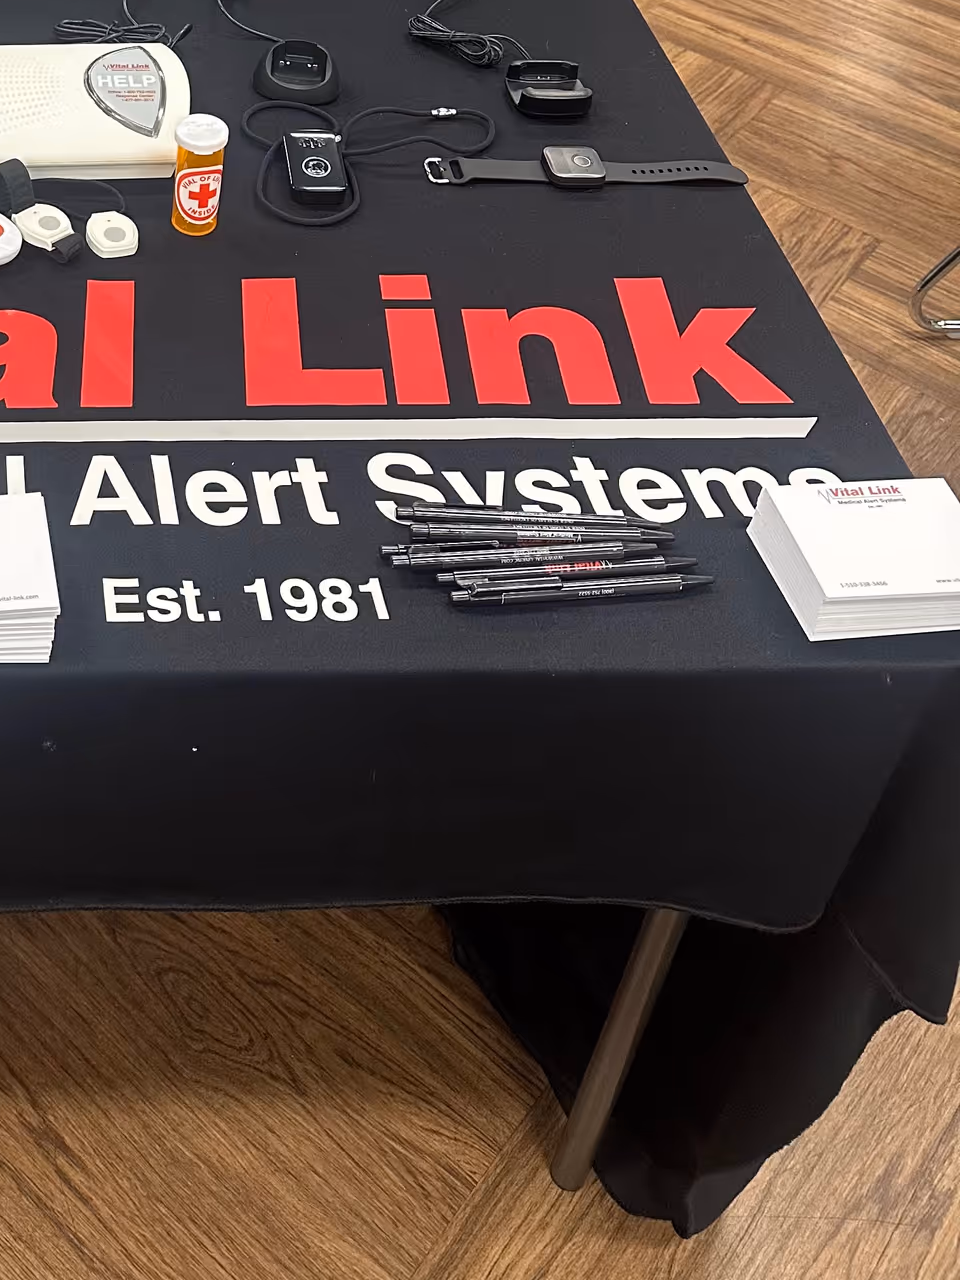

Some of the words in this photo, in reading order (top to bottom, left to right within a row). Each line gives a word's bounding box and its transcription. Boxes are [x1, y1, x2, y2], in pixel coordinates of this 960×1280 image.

[97, 74, 157, 87] HELP
[182, 178, 198, 190] VIAL
[241, 275, 795, 407] Link
[69, 454, 340, 527] Alert
[366, 452, 841, 525] System
[829, 486, 864, 498] Vital
[869, 485, 901, 495] Link
[573, 561, 602, 571] Vital
[104, 577, 222, 623] Est.
[243, 577, 393, 622] 1981
